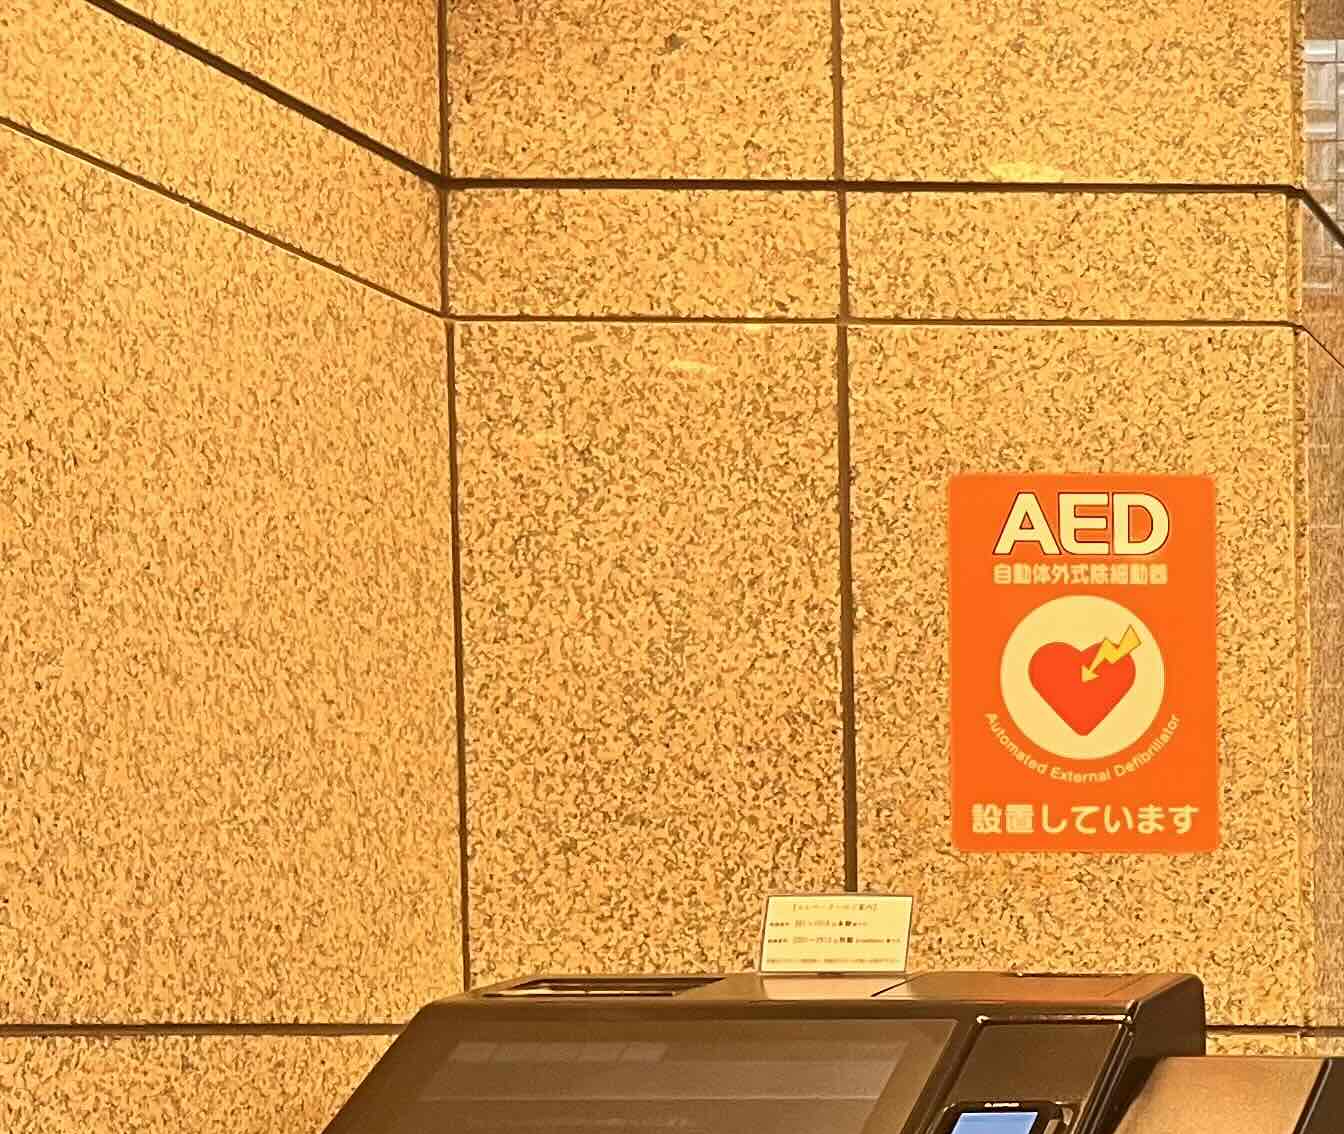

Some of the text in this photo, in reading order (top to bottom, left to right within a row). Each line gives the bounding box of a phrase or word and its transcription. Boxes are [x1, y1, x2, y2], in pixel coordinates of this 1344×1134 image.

[992, 491, 1170, 556] AED
[992, 562, 1168, 585] 自動体外式除細動器
[983, 712, 1181, 784] Automated External Defibrillator
[971, 803, 1199, 835] 設置しています
